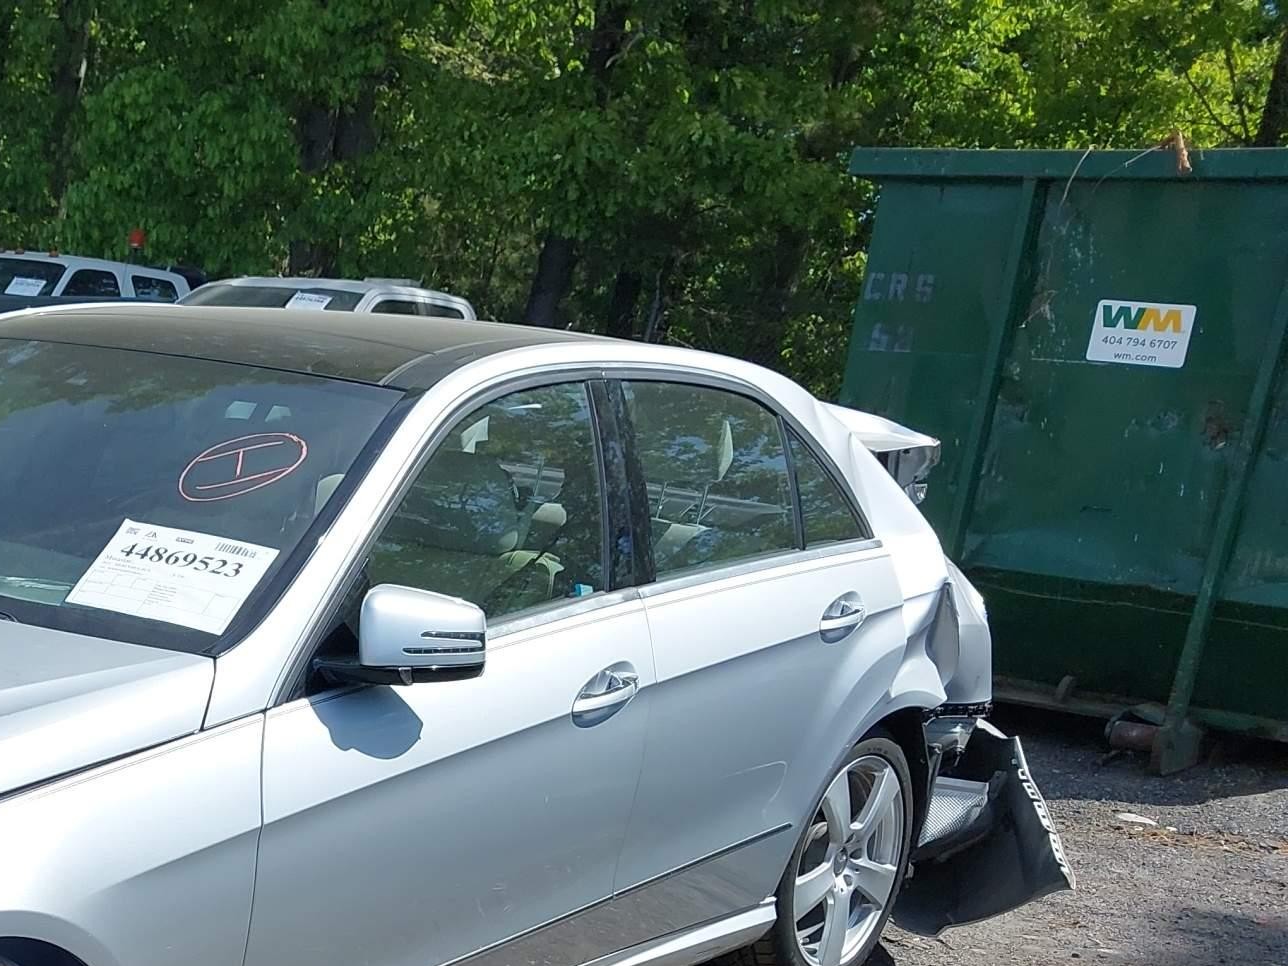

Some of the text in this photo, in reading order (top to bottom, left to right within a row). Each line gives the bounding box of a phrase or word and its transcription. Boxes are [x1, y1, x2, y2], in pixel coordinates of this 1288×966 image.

[1103, 304, 1182, 333] WM
[1101, 335, 1179, 351] 404 794 6707
[1113, 352, 1158, 363] wm.com
[120, 542, 244, 578] 44869523
